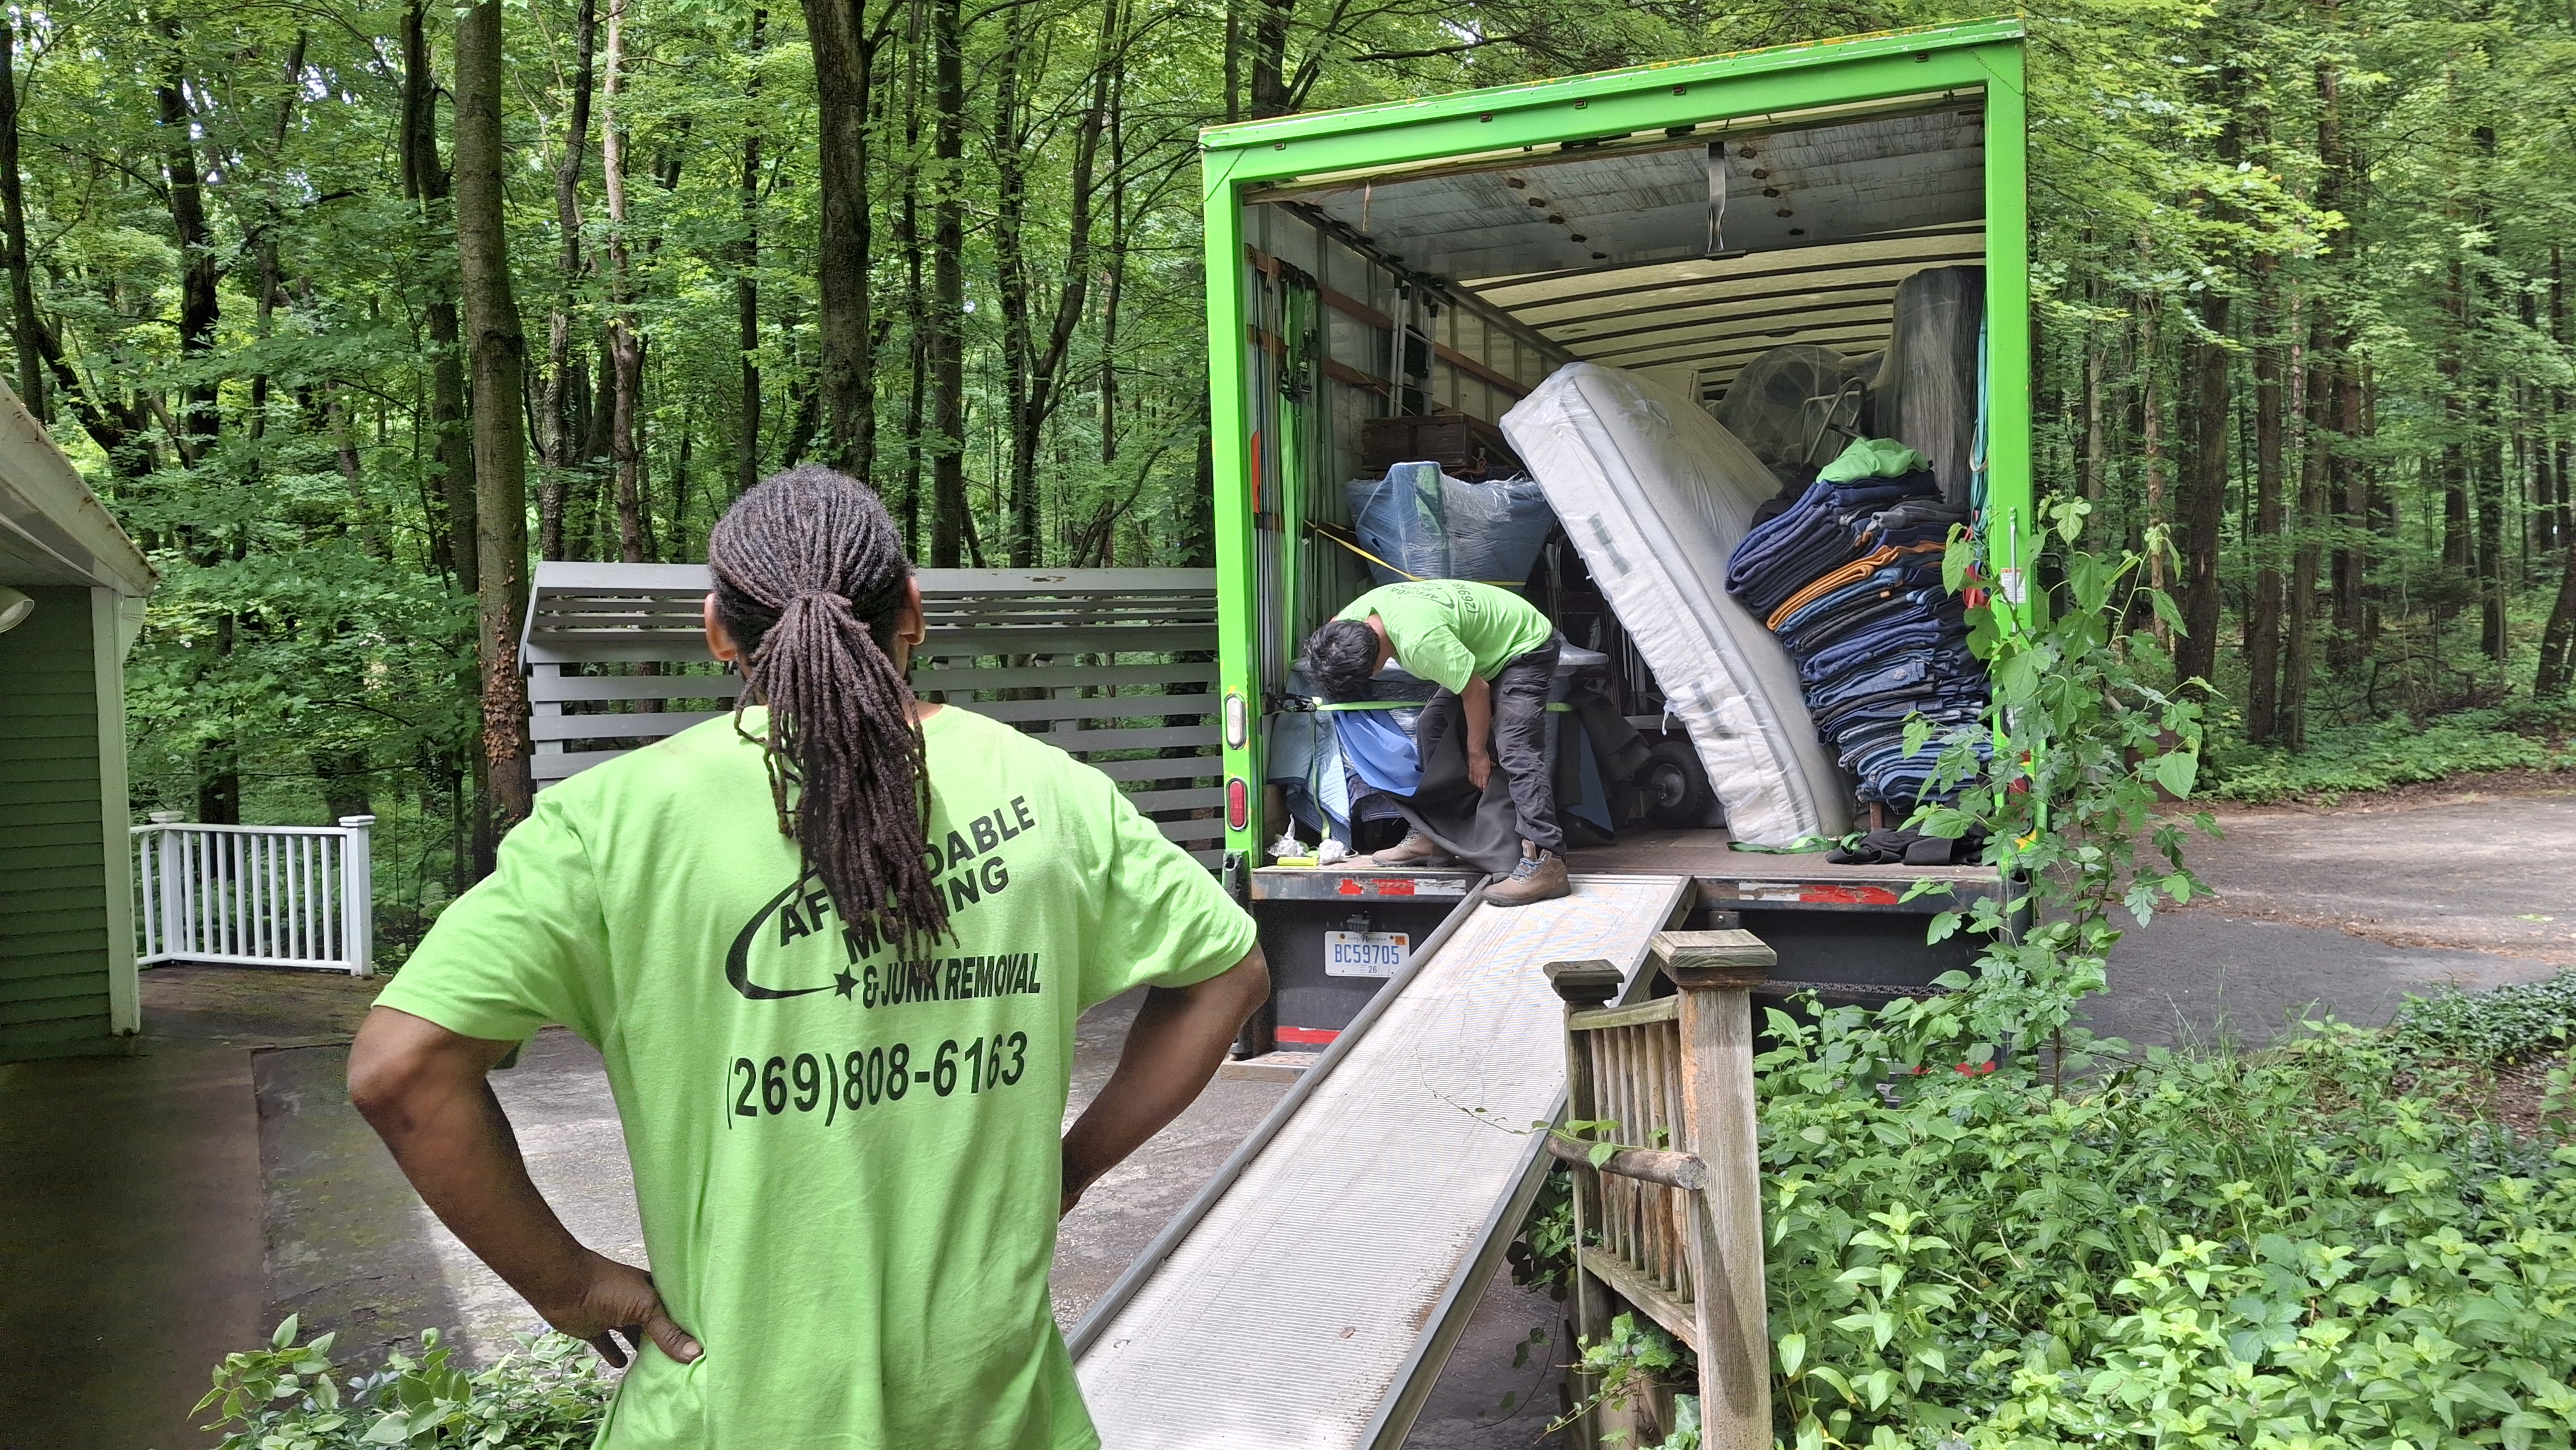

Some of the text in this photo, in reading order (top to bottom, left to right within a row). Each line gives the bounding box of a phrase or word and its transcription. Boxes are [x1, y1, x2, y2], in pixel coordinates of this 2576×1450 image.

[780, 795, 1035, 947] AFDABLE
[841, 856, 1010, 966] MNG
[1357, 934, 1387, 944] MICHIGAN
[862, 952, 1041, 1009] & JUNK REMOVAL
[1334, 944, 1400, 965] BC59705
[1368, 965, 1378, 974] 26
[727, 1031, 1028, 1130] (269)808-6163
